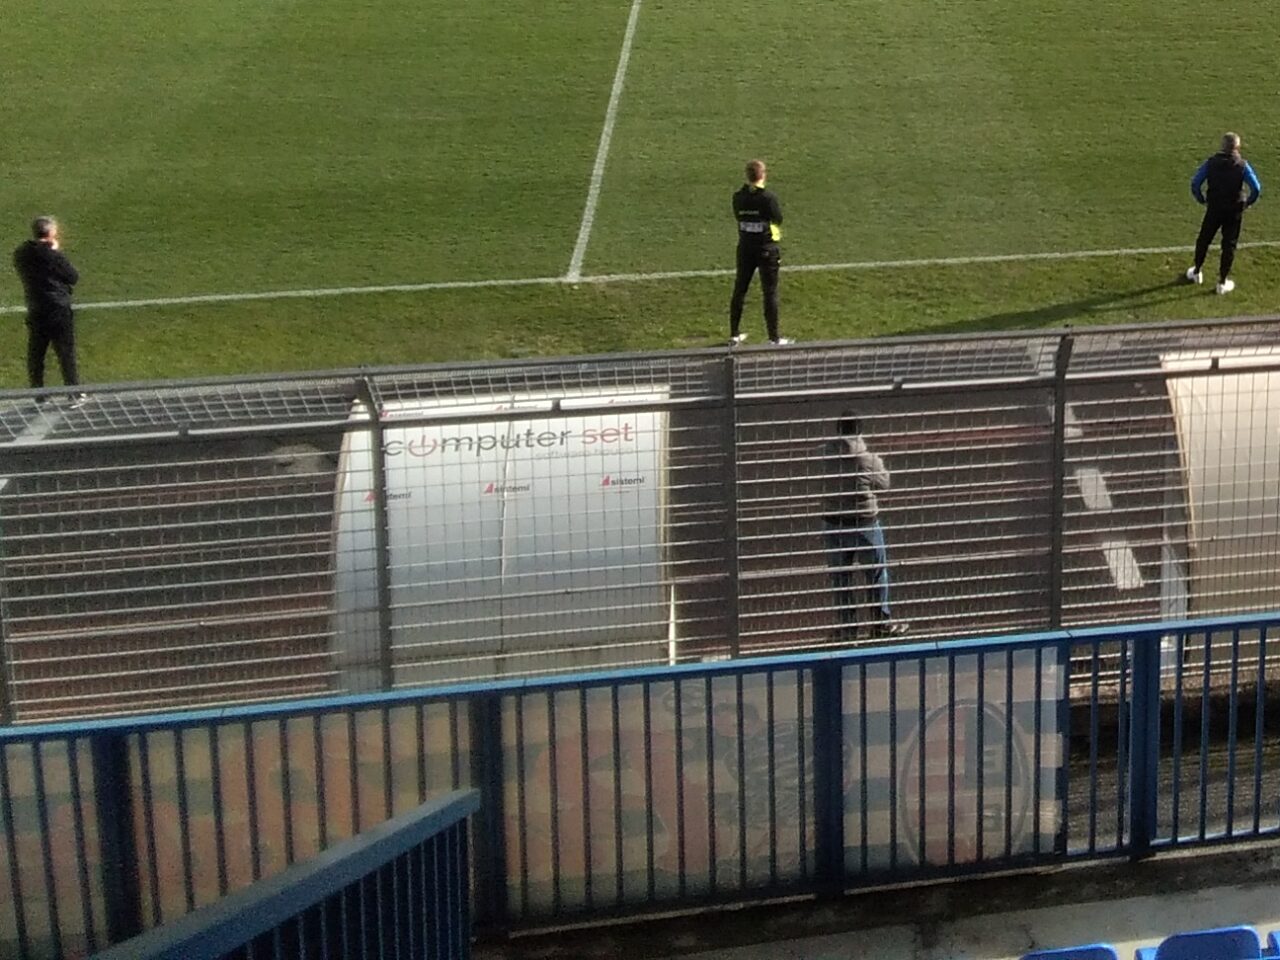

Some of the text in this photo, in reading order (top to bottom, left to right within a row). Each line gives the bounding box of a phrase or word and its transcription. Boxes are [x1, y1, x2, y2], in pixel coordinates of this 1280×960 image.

[383, 422, 634, 458] computer set
[611, 476, 645, 486] sistemi
[383, 491, 412, 502] stemi
